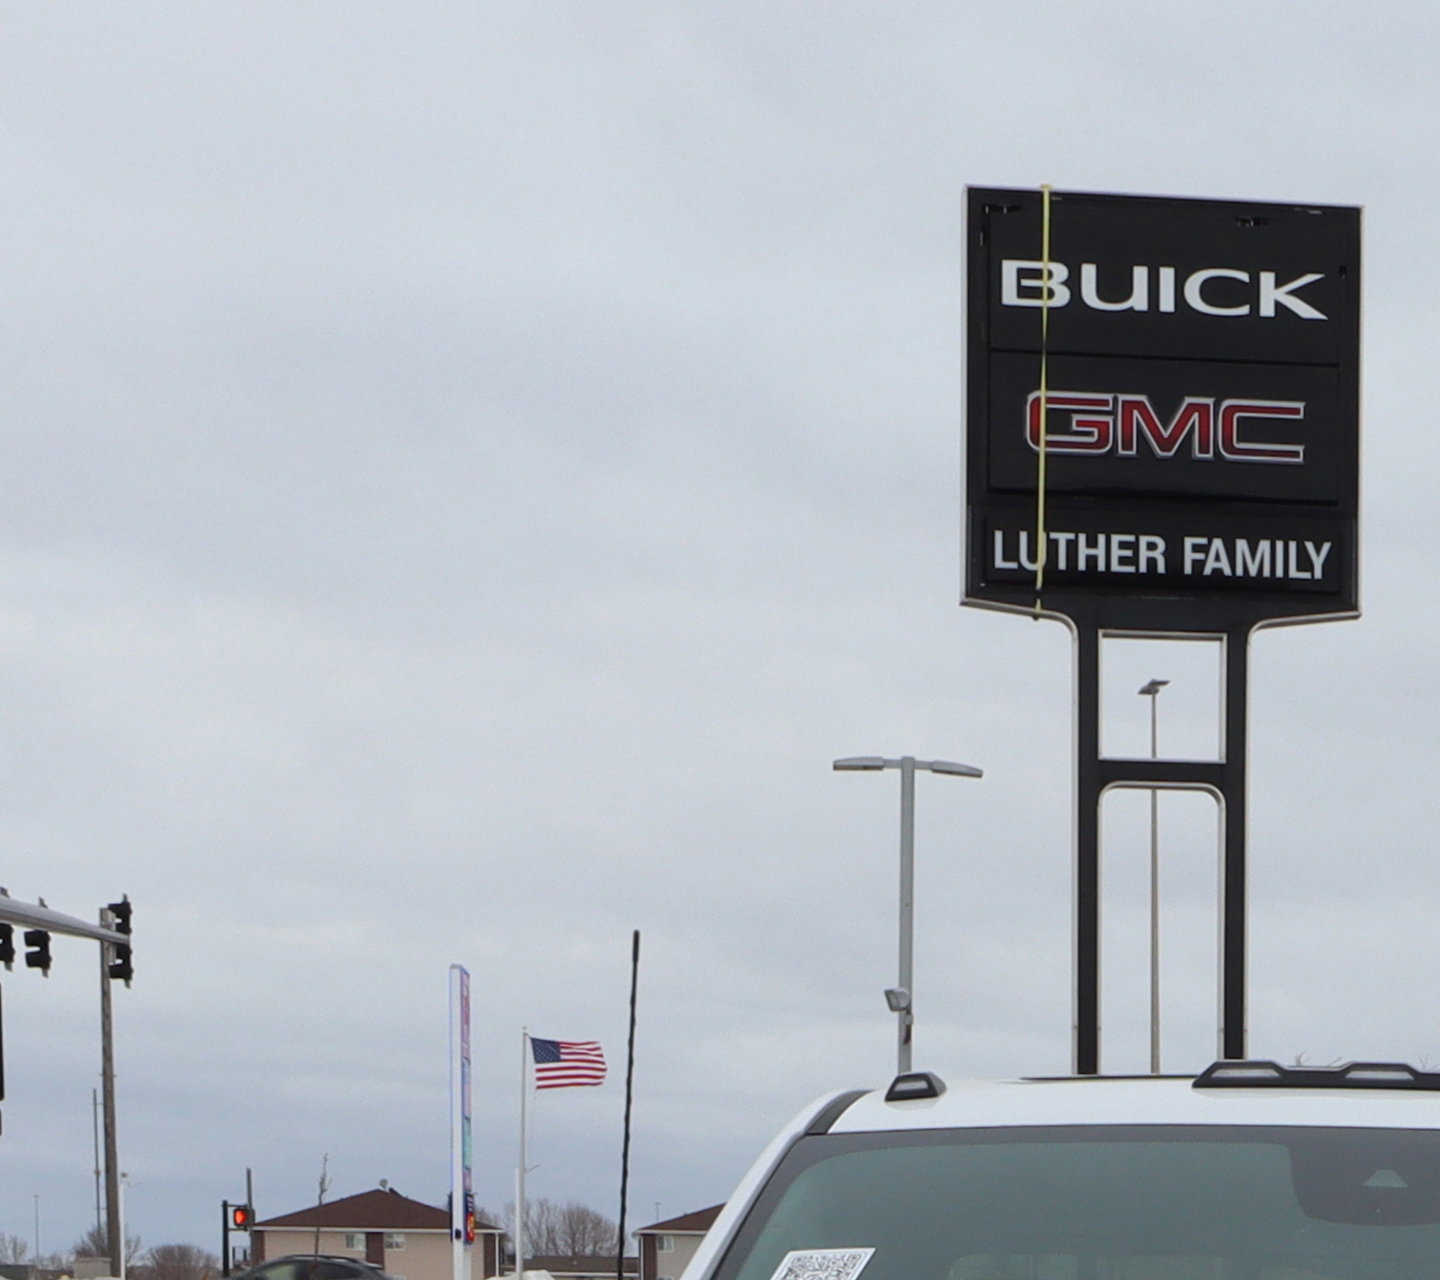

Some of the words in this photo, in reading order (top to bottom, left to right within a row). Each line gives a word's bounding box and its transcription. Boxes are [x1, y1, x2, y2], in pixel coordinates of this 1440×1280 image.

[1001, 259, 1328, 320] BUICK
[1025, 389, 1305, 464] GMC
[994, 530, 1166, 575] LUTHER
[1183, 537, 1332, 580] FAMILY
